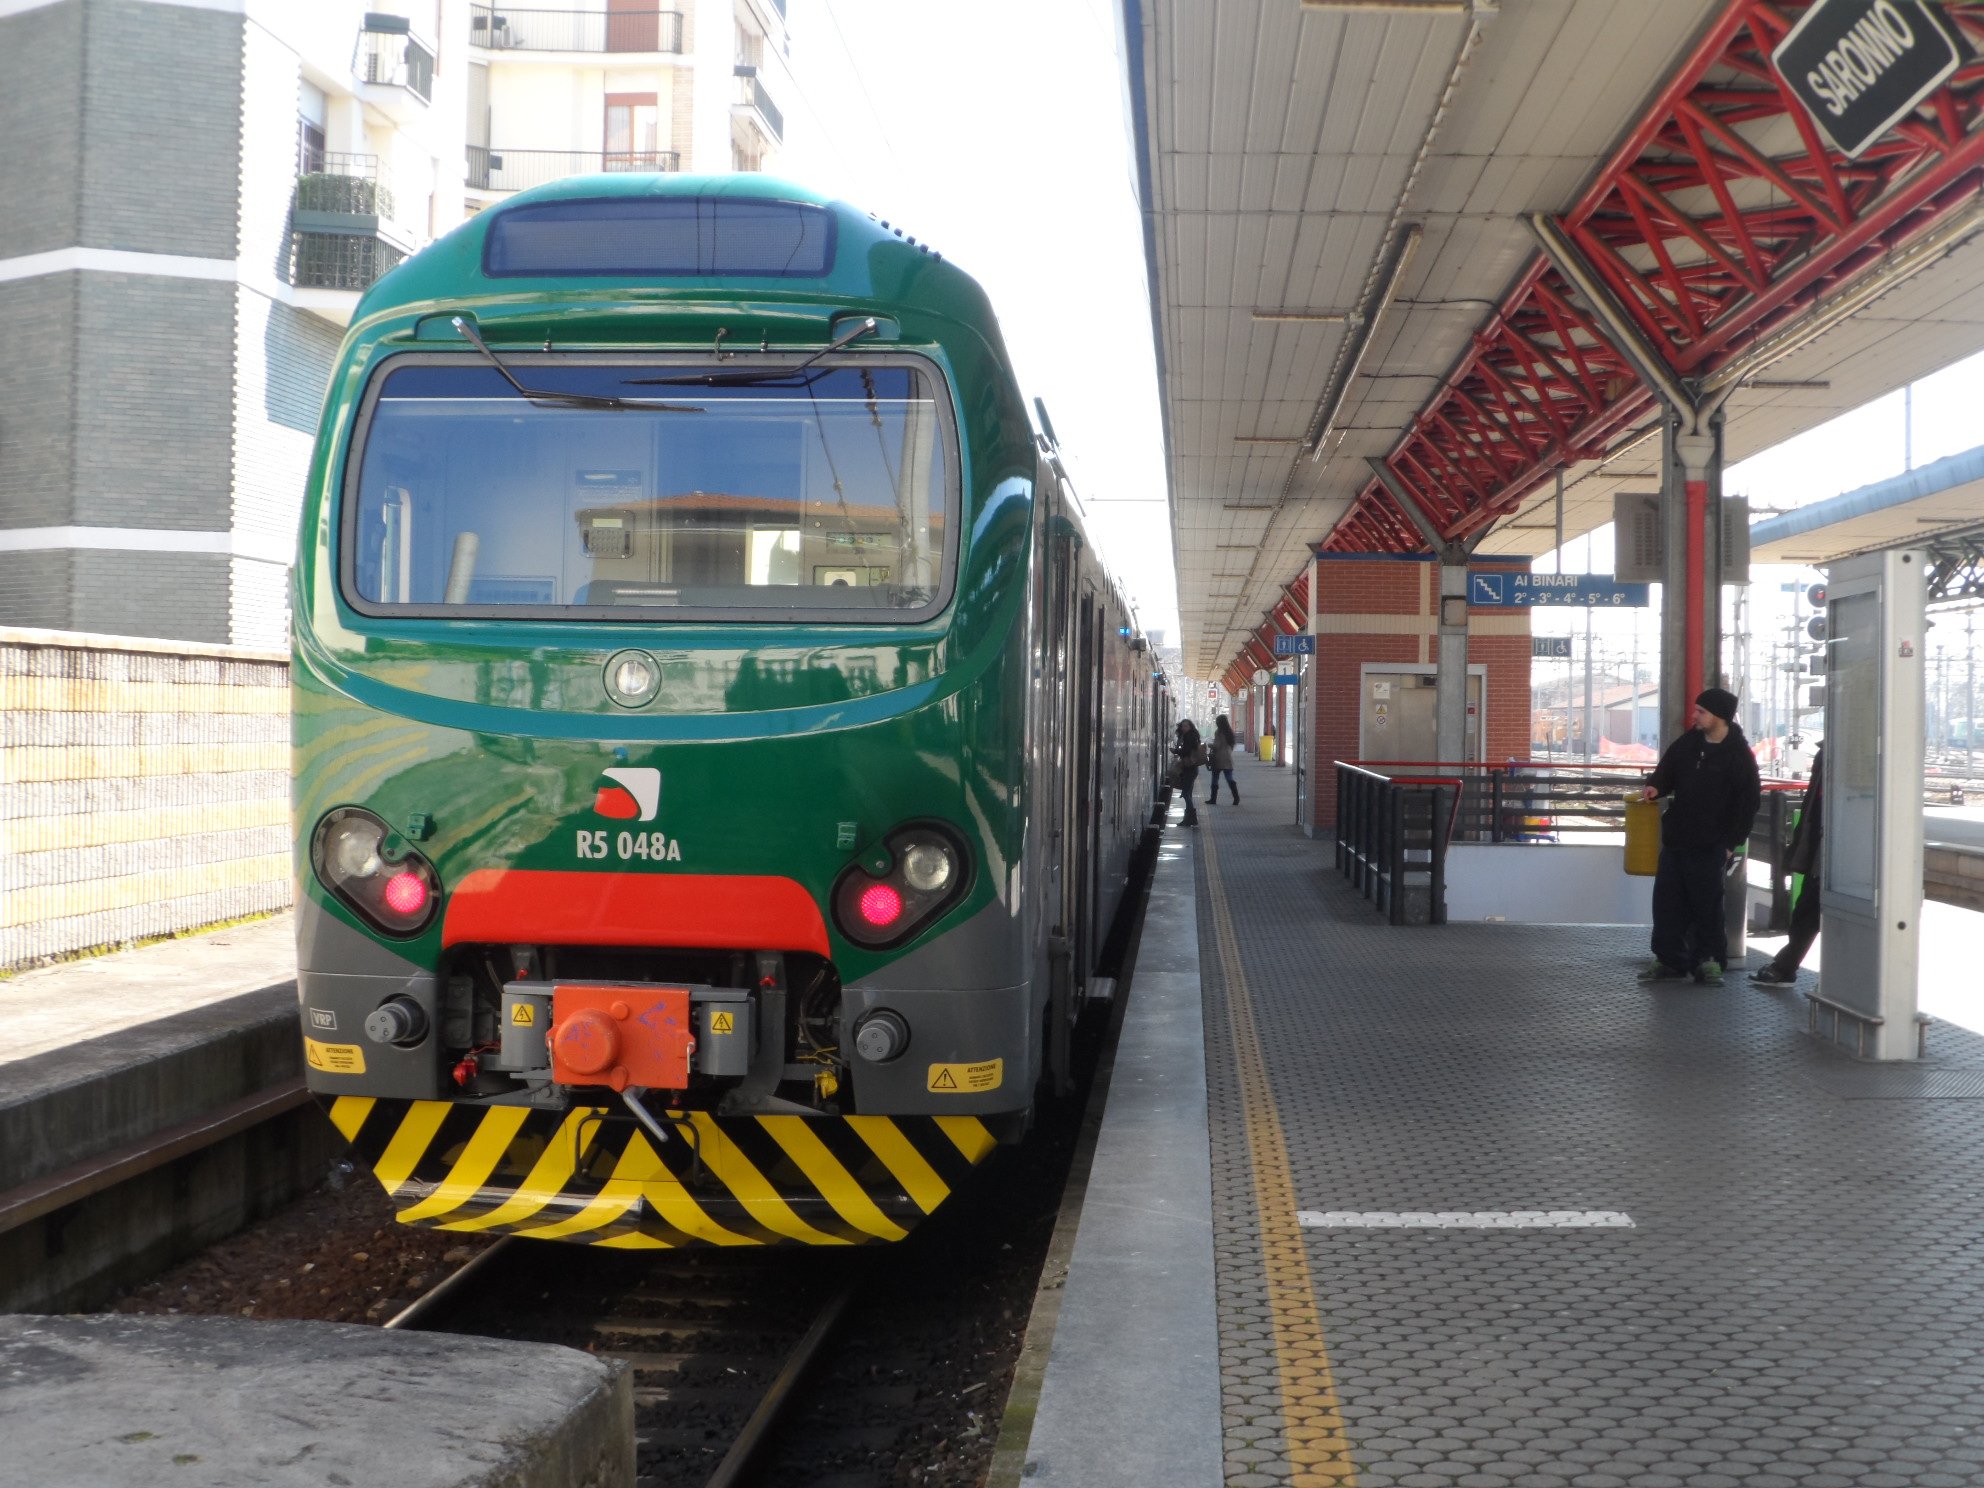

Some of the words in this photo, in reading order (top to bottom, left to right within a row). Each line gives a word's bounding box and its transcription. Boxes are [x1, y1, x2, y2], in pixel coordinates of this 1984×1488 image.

[1807, 0, 1915, 116] SARONNO
[1514, 575, 1528, 587] AI
[1532, 575, 1578, 587] BINARI
[576, 830, 608, 858] R5
[617, 831, 681, 861] 048A
[312, 1012, 332, 1026] VRP
